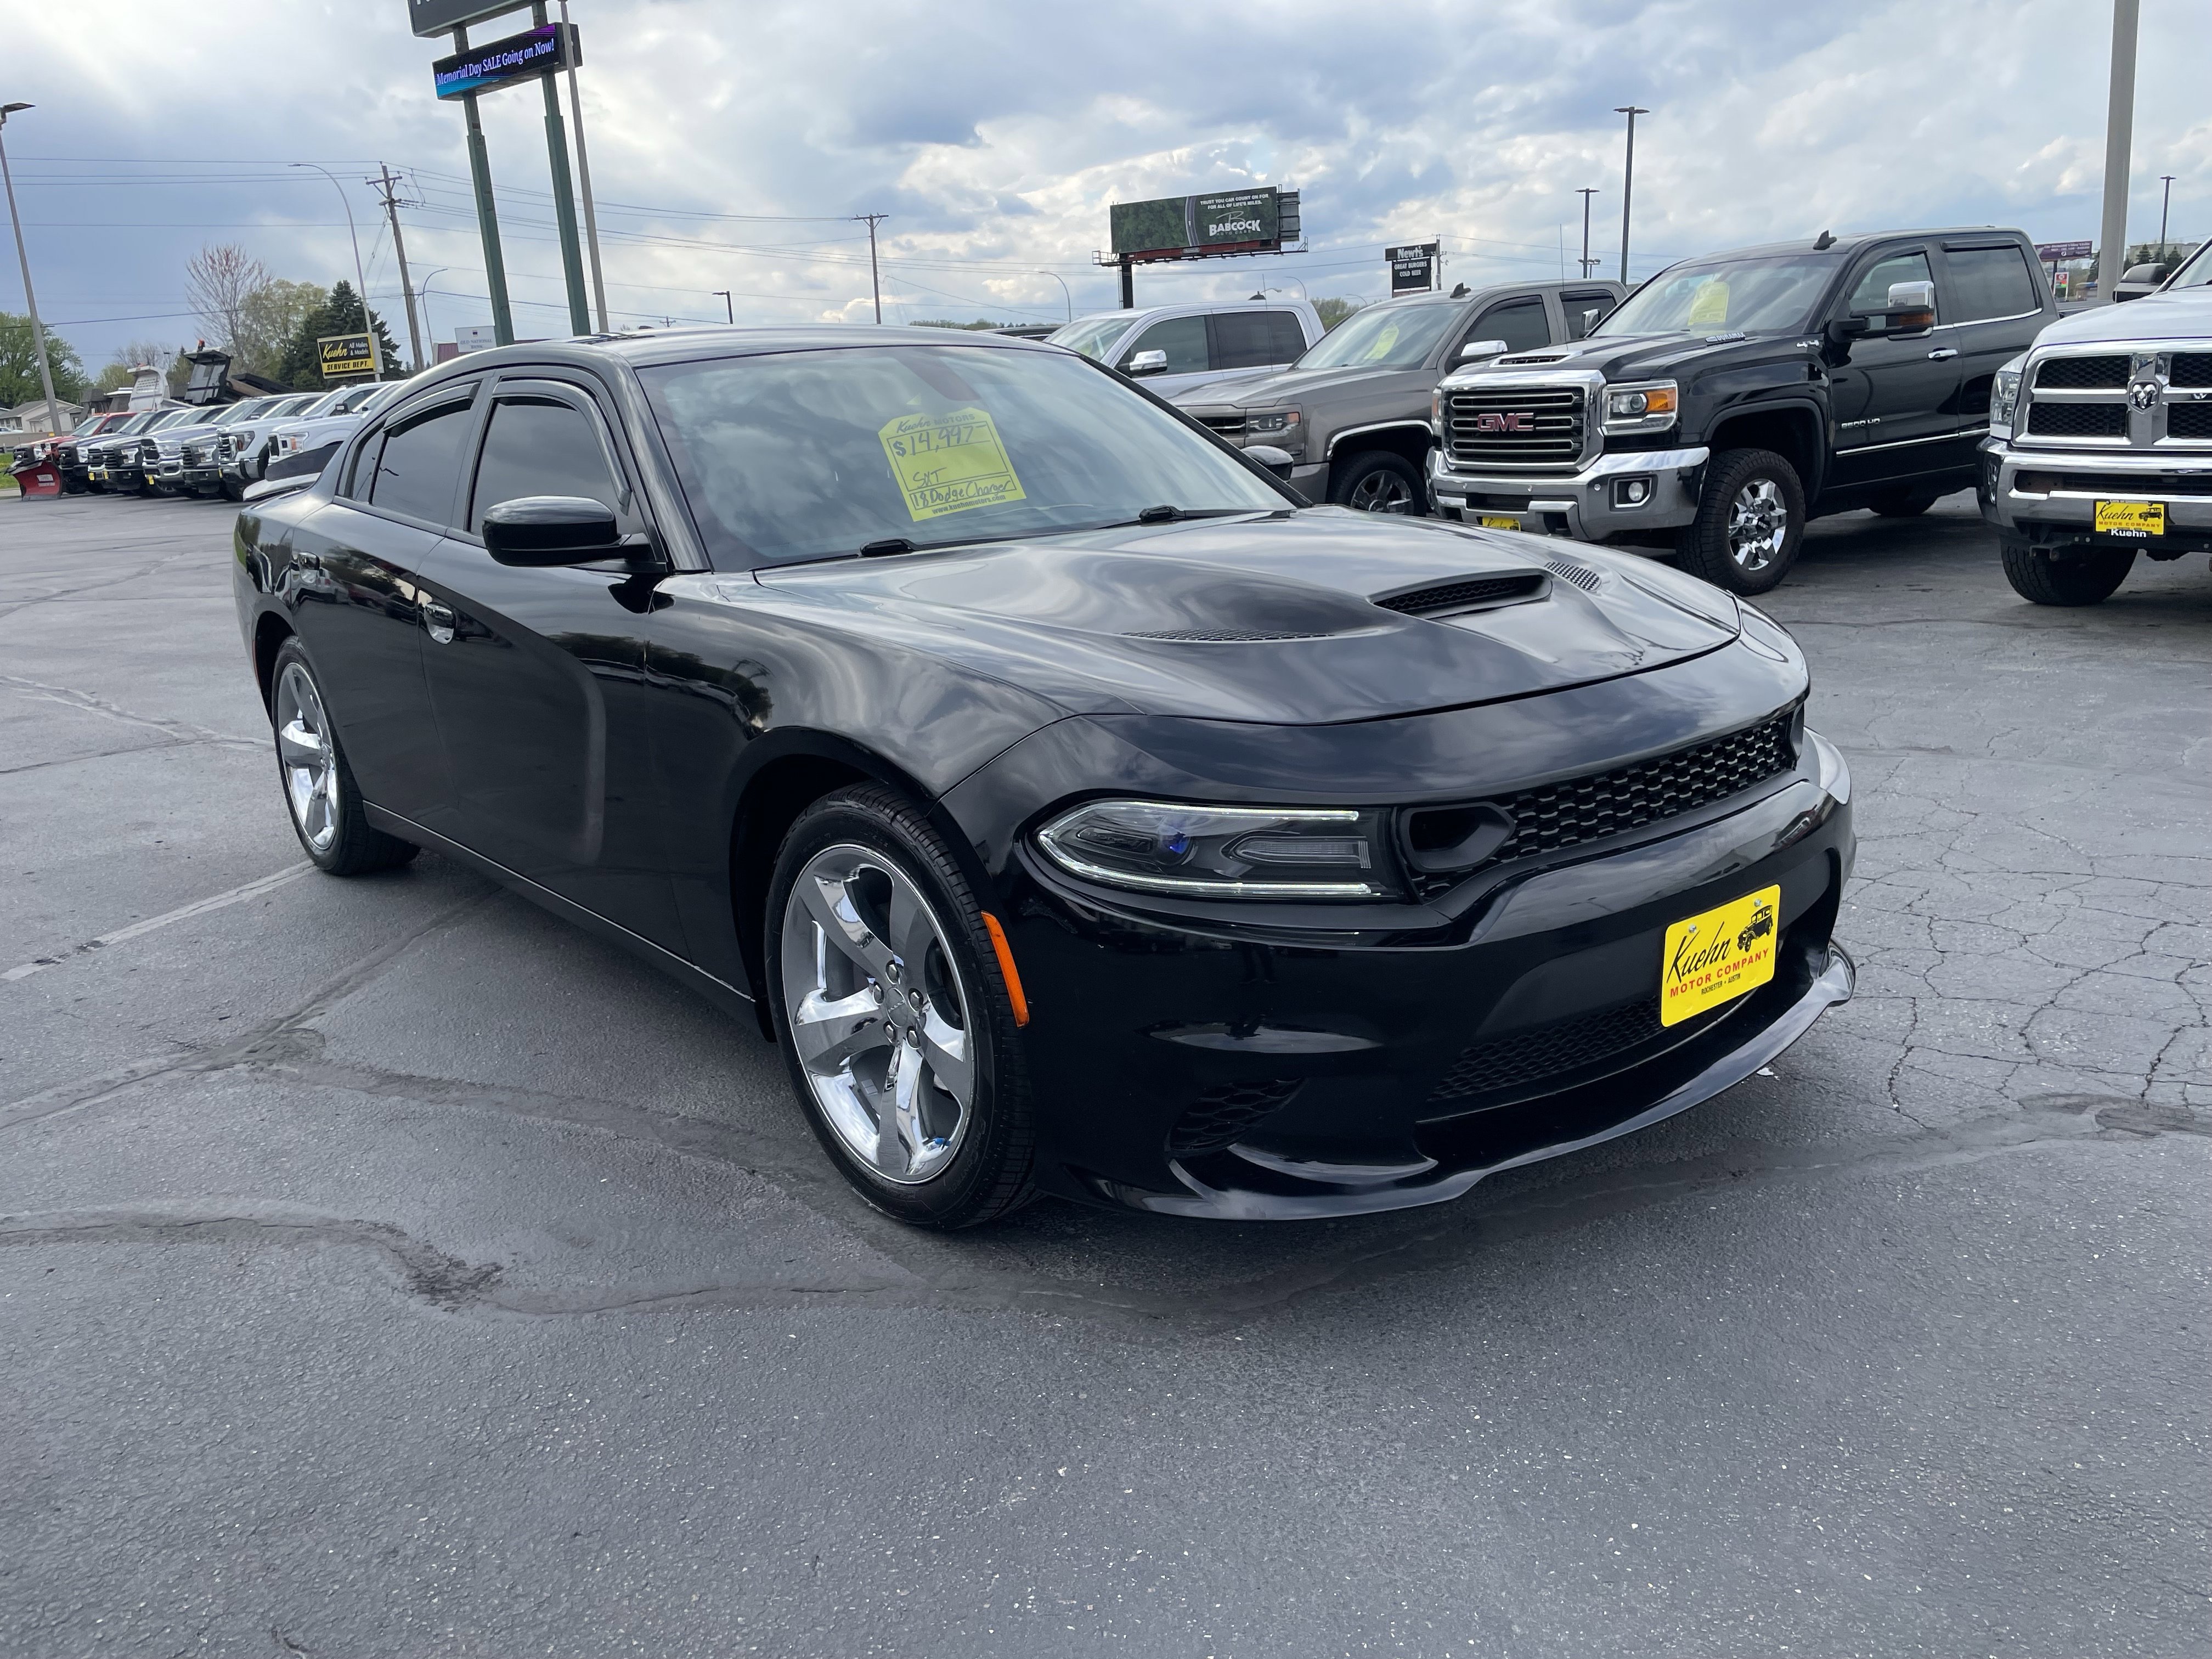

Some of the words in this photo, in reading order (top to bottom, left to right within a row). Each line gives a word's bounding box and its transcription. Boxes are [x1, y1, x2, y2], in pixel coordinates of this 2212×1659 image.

[437, 64, 469, 86] Memorial
[469, 64, 482, 77] Day
[483, 55, 501, 71] SALE
[502, 50, 523, 65] Going
[524, 47, 533, 59] on
[534, 37, 554, 56] Now!
[1209, 219, 1261, 236] BABCOCK
[1397, 245, 1424, 259] Newt's
[1716, 332, 1746, 341] DURAMAX
[323, 342, 348, 360] Kuehn
[327, 362, 351, 371] SERVICE
[896, 416, 932, 433] Kuehn
[934, 414, 975, 426] MOTORS
[1477, 413, 1534, 432] GMC
[930, 486, 963, 503] Dodge
[965, 481, 1011, 498] Charger
[932, 494, 1006, 514] www.kuehnmotors.com
[2096, 504, 2135, 521] Kuehn
[2111, 528, 2147, 538] Kuehn
[1666, 921, 1731, 984] Kuehn
[1670, 973, 1712, 998] MOTOR
[1717, 948, 1769, 978] COMPANY
[1701, 980, 1723, 995] ROCHESTER
[1728, 972, 1741, 984] AUSTIN
